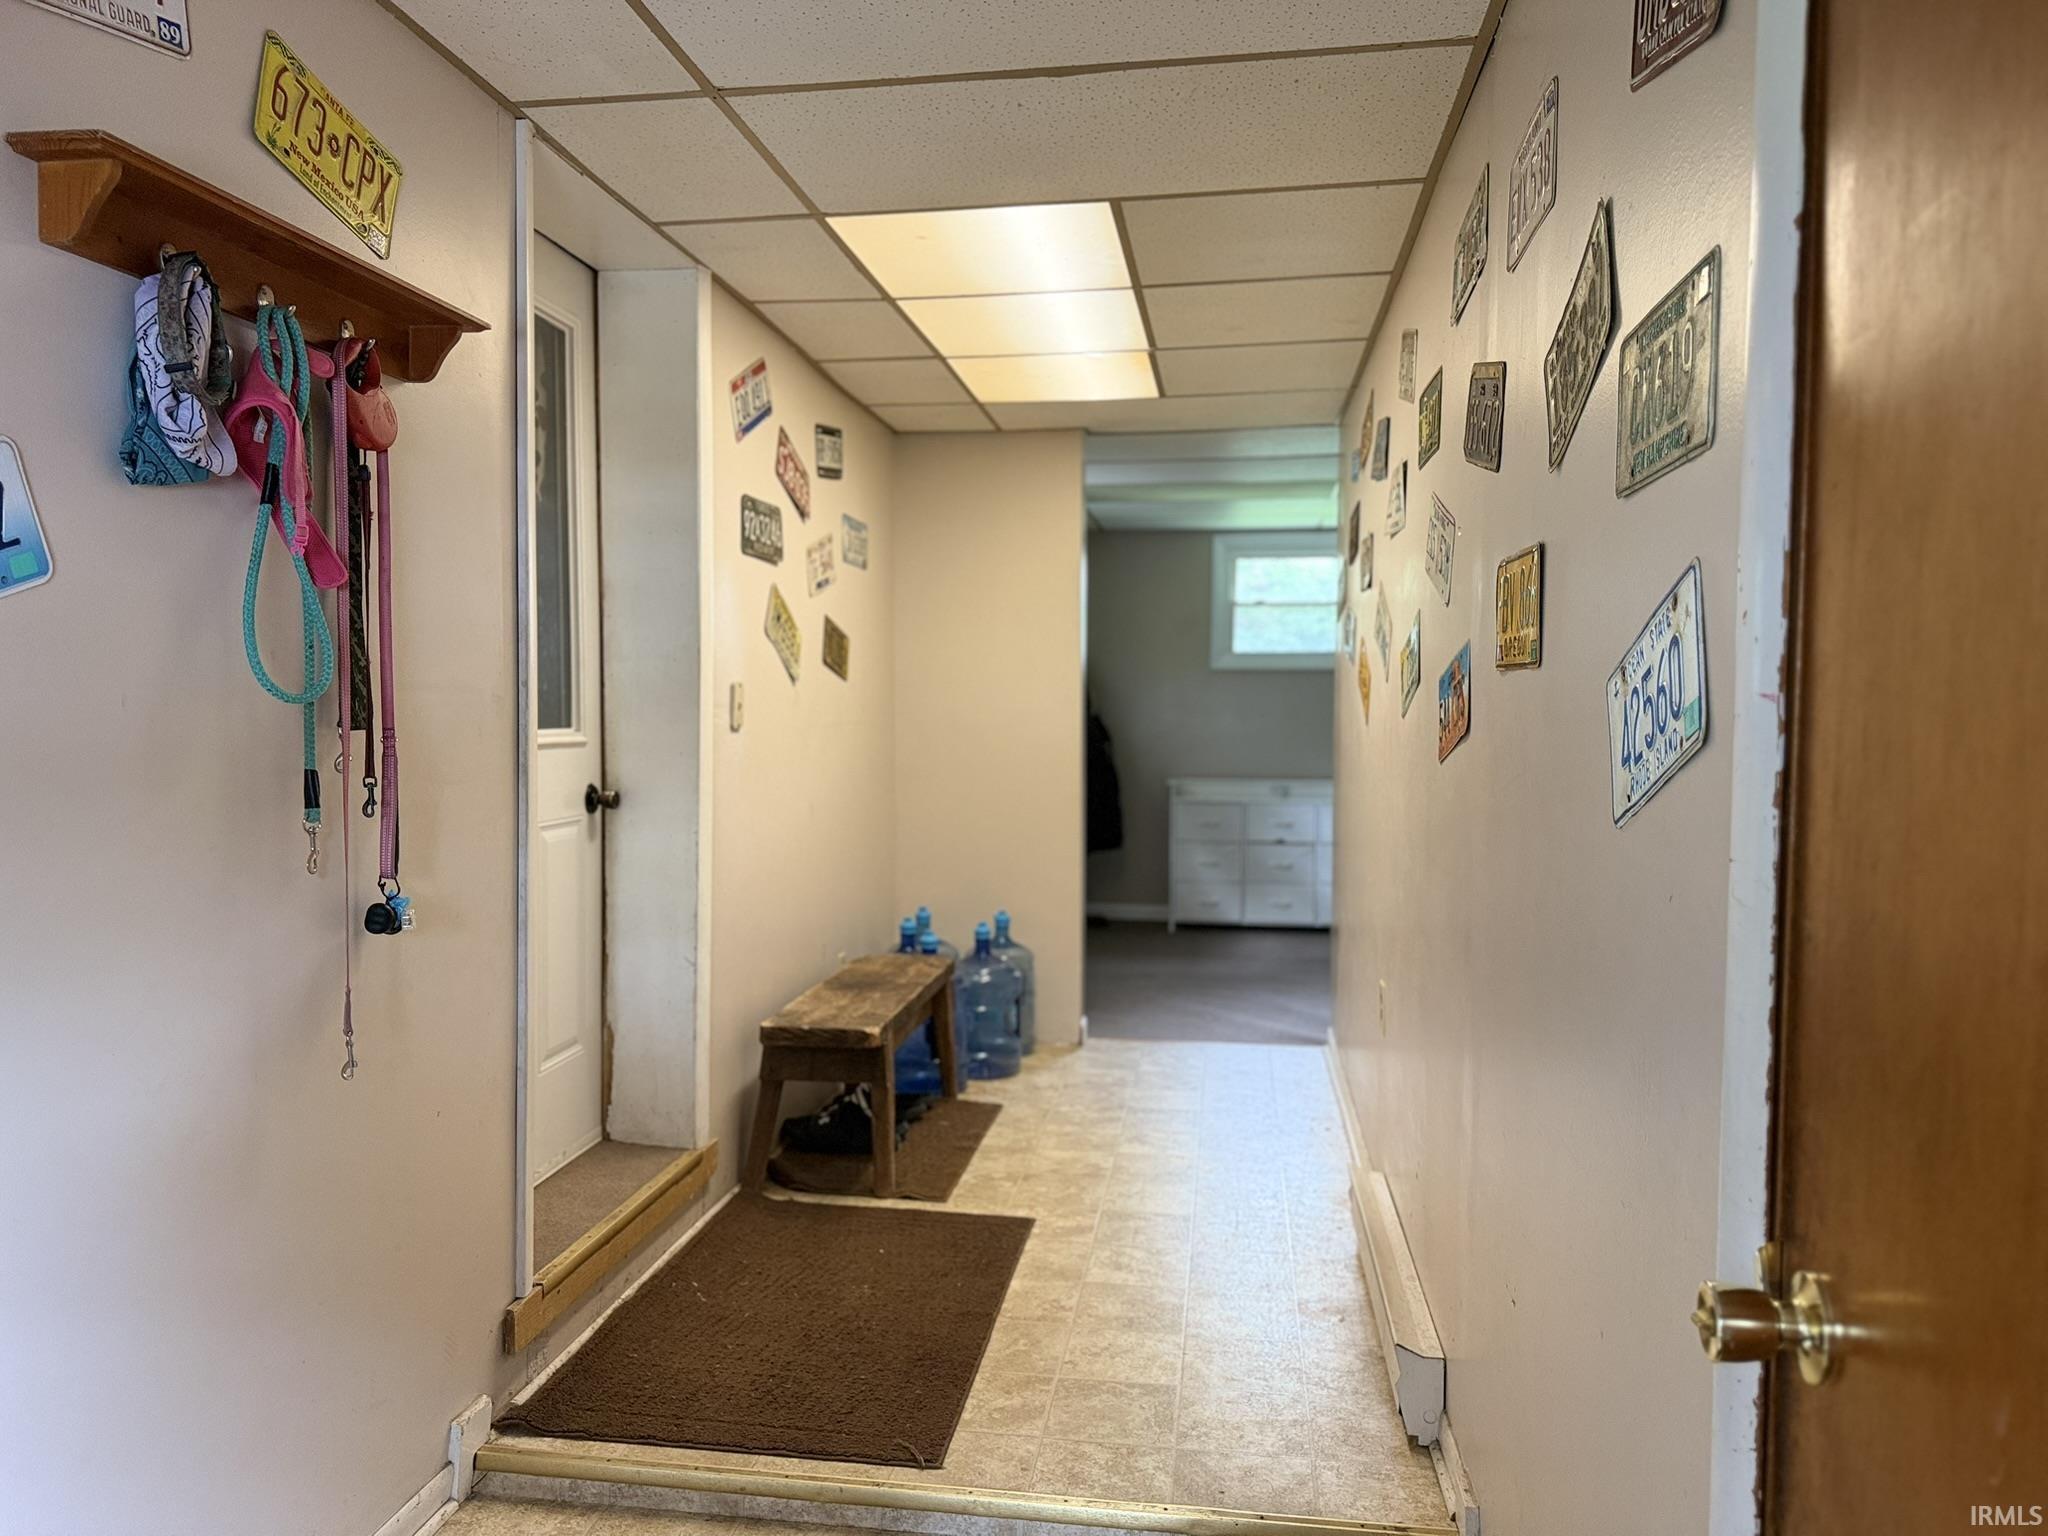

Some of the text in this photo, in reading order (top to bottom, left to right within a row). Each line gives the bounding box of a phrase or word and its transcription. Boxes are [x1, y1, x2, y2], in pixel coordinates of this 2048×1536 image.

[109, 2, 150, 33] GUARD
[160, 22, 180, 44] 89
[272, 65, 393, 225] 673 CPX
[289, 140, 365, 223] New Mexico USA
[1650, 606, 1671, 651] STATE
[1621, 634, 1684, 773] 42560
[1630, 728, 1678, 796] RHODE ISLAND
